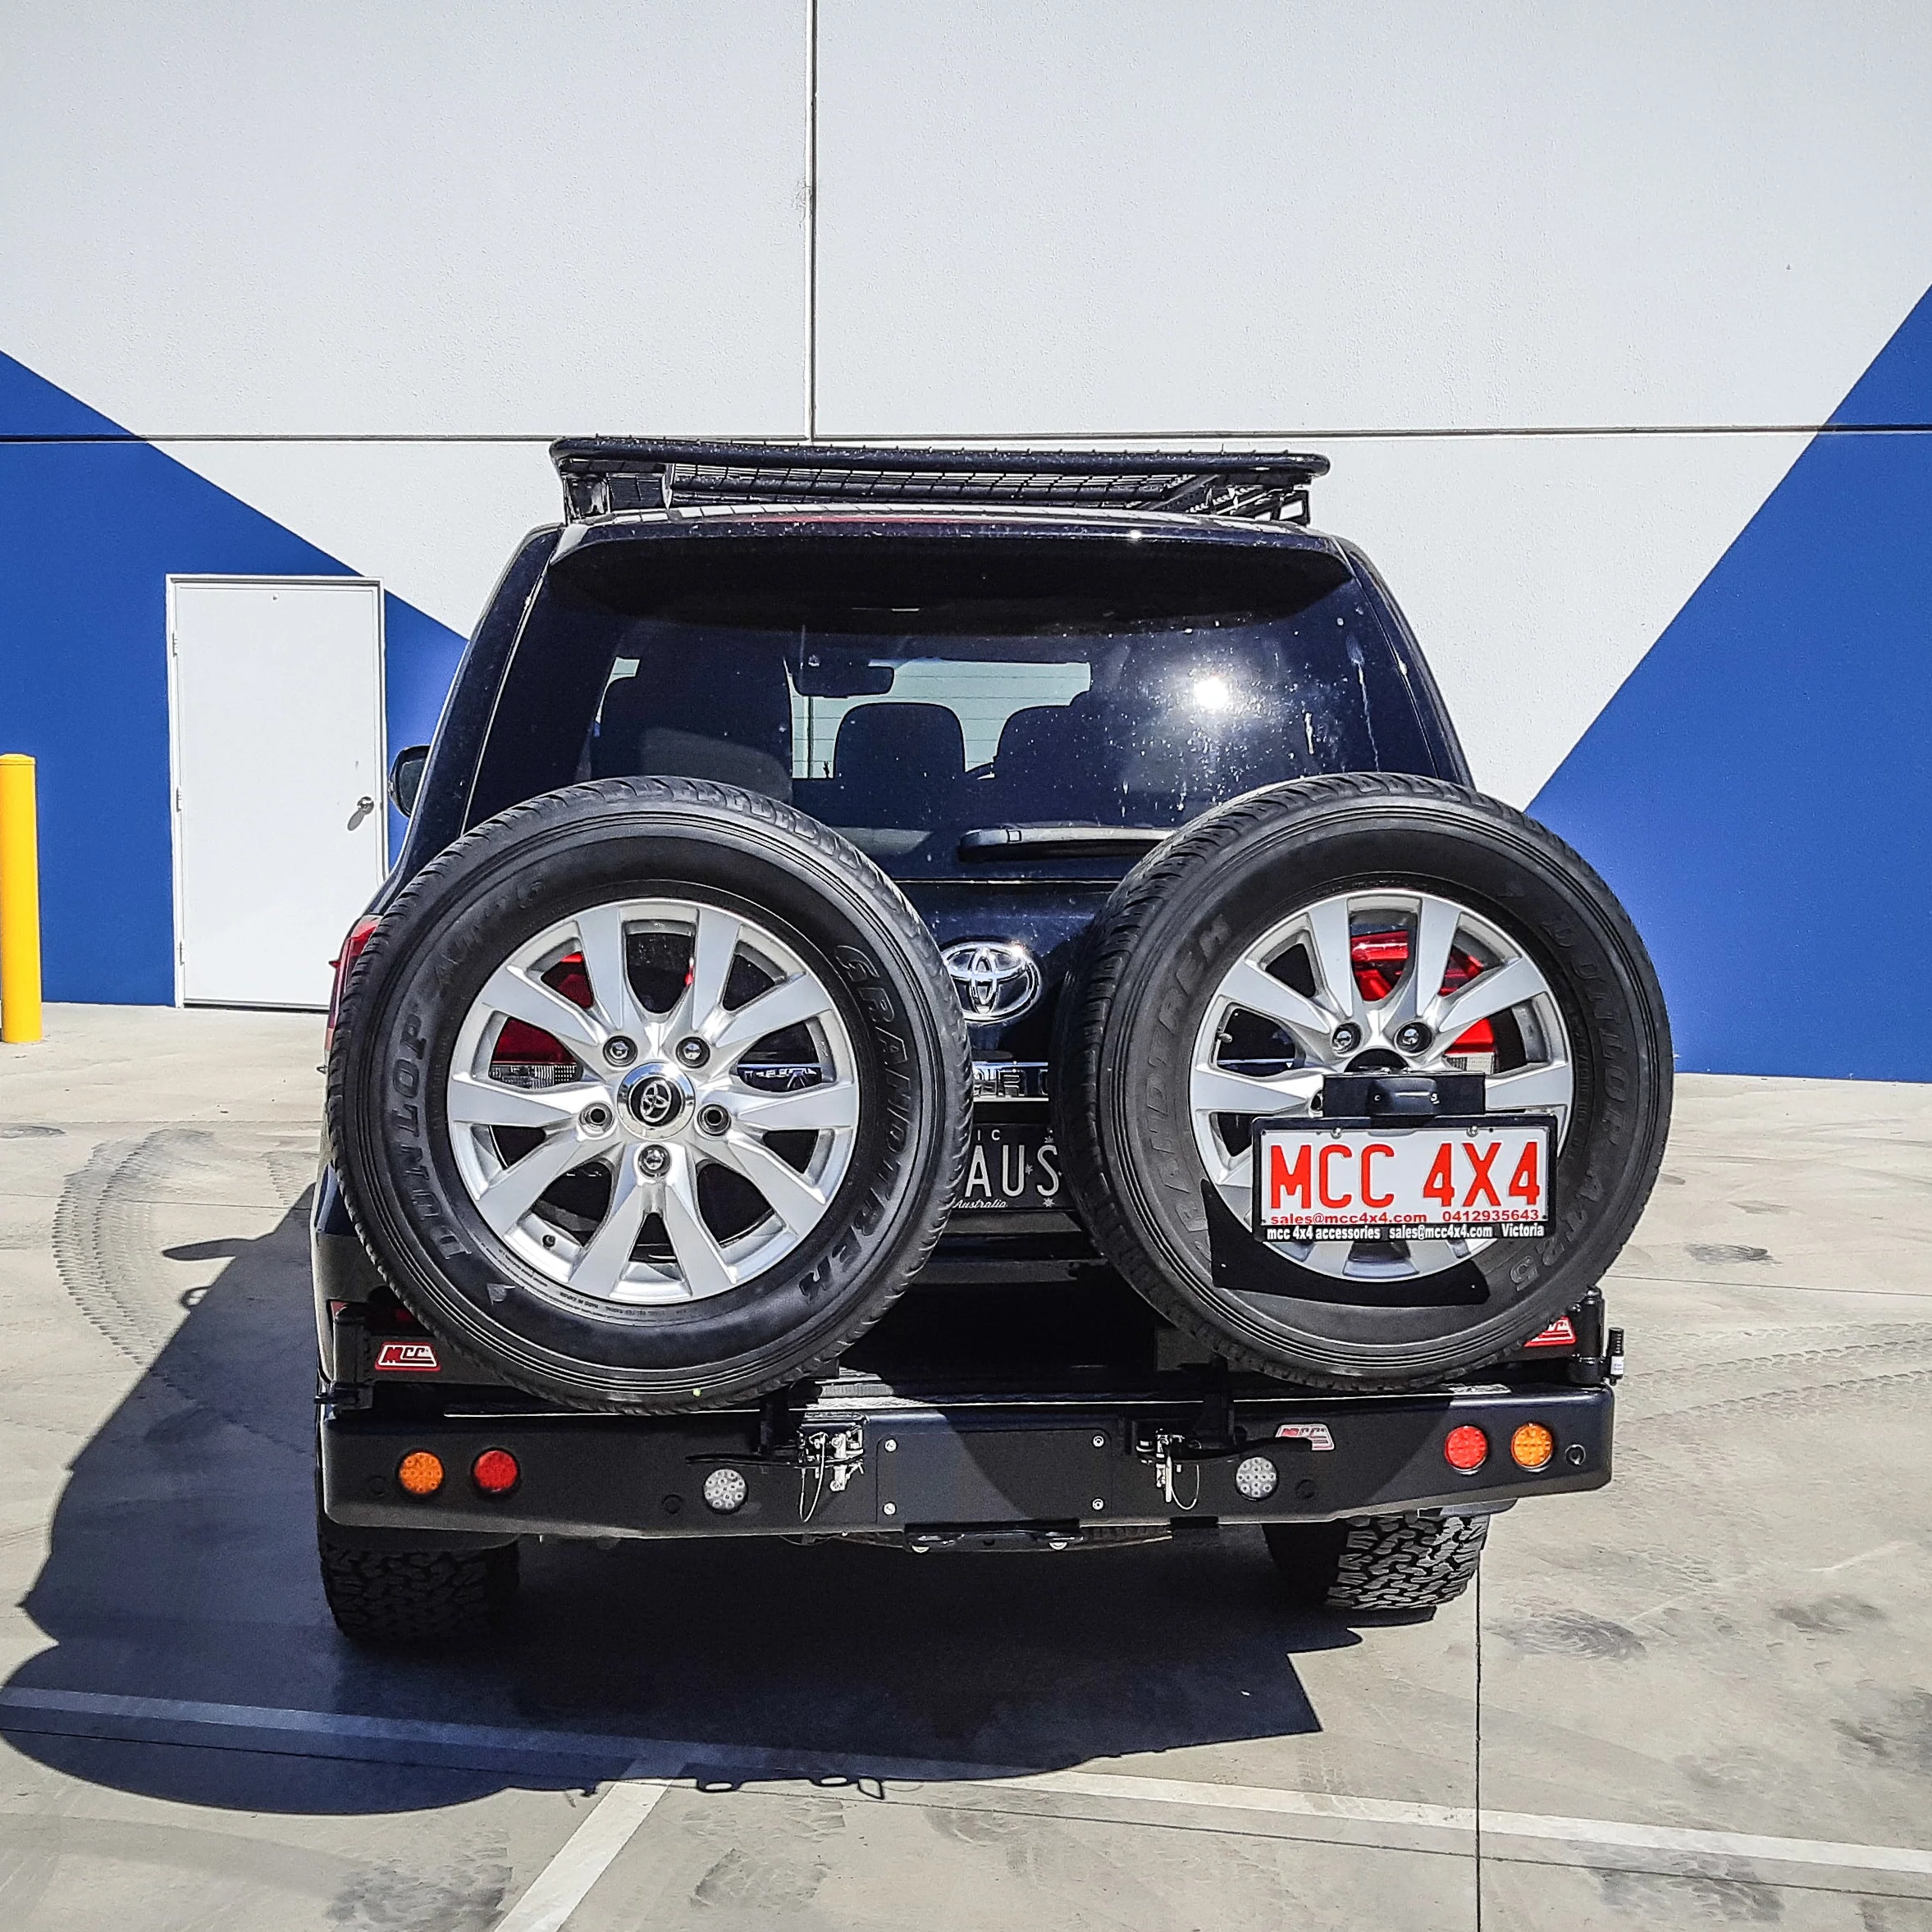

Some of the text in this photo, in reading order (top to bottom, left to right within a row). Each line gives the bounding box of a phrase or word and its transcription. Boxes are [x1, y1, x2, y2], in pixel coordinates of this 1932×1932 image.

[798, 945, 911, 1304] GRANDTREK
[1509, 916, 1628, 1291] DUNLOP AT25
[393, 1013, 472, 1260] DUNLOP
[1270, 1141, 1540, 1209] MCC 4X4
[952, 1198, 1008, 1209] Australia
[1271, 1209, 1539, 1225] sales@mcc4x4.com 0412935643
[1267, 1223, 1545, 1240] mcc 4x4 accessories sales@mcc4x4.com Victoria
[380, 1346, 433, 1364] MCC
